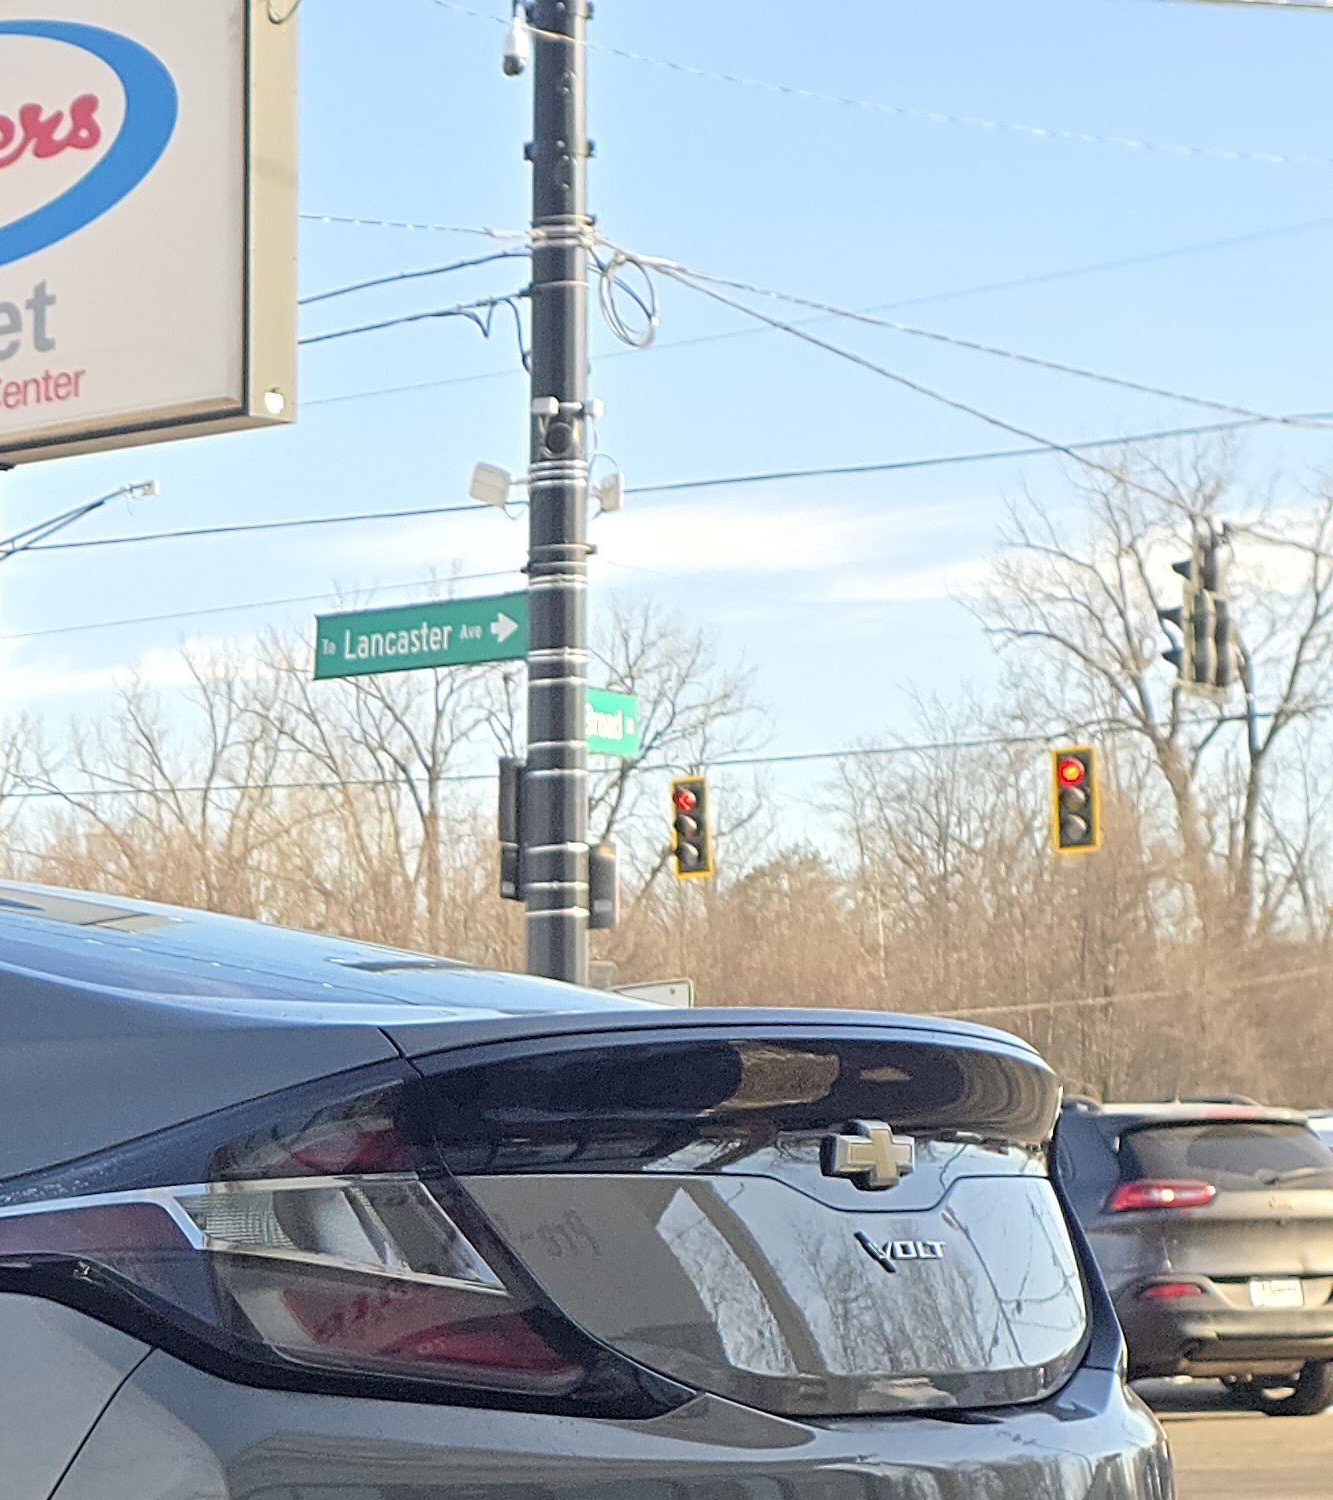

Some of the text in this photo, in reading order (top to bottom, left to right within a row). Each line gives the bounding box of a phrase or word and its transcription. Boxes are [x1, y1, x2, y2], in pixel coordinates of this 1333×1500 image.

[344, 621, 453, 660] Lancaster
[459, 624, 483, 640] Ave
[853, 1231, 947, 1273] VOLT
